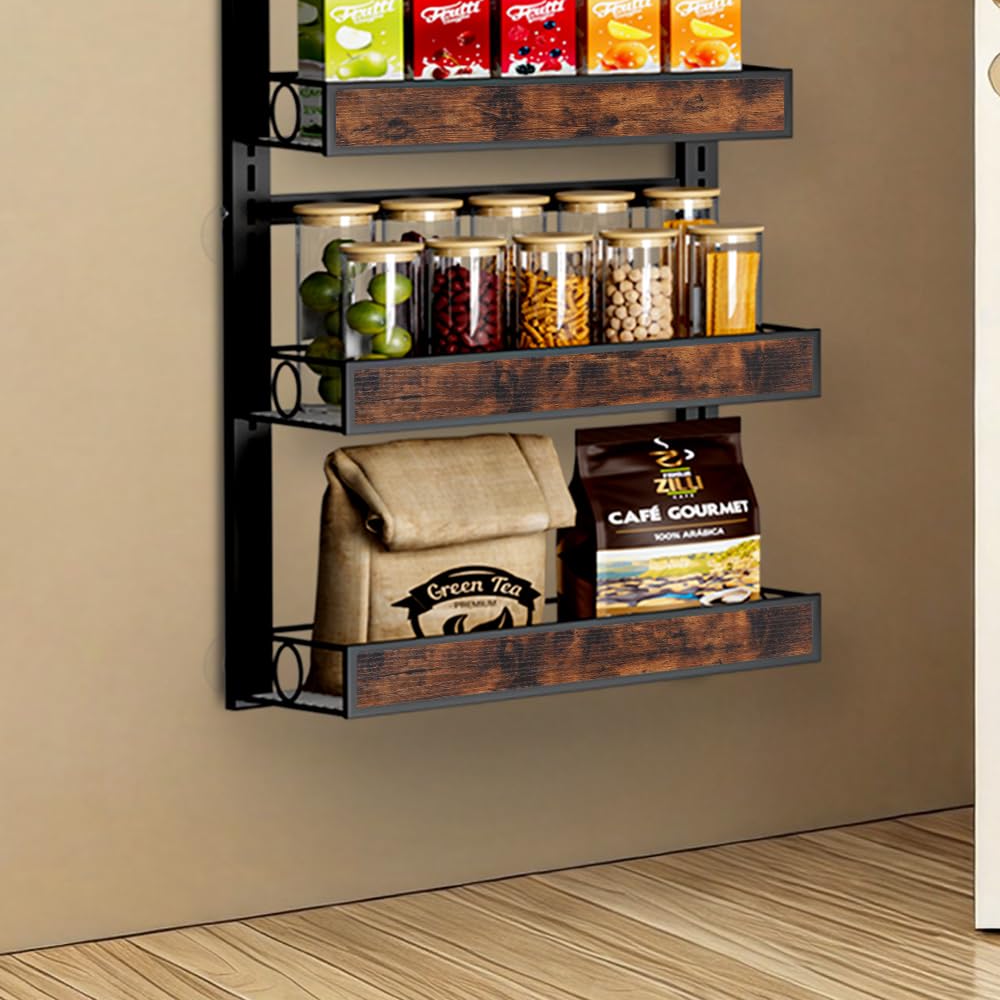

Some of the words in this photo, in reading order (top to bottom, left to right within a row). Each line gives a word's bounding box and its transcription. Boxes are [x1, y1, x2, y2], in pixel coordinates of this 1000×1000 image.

[653, 475, 704, 493] ZILLI
[608, 505, 661, 525] CAFÉ
[668, 500, 749, 520] GOURMET
[653, 531, 681, 541] 100%
[427, 580, 484, 600] Green
[491, 576, 523, 597] Tea
[454, 600, 497, 609] PREMIUM
